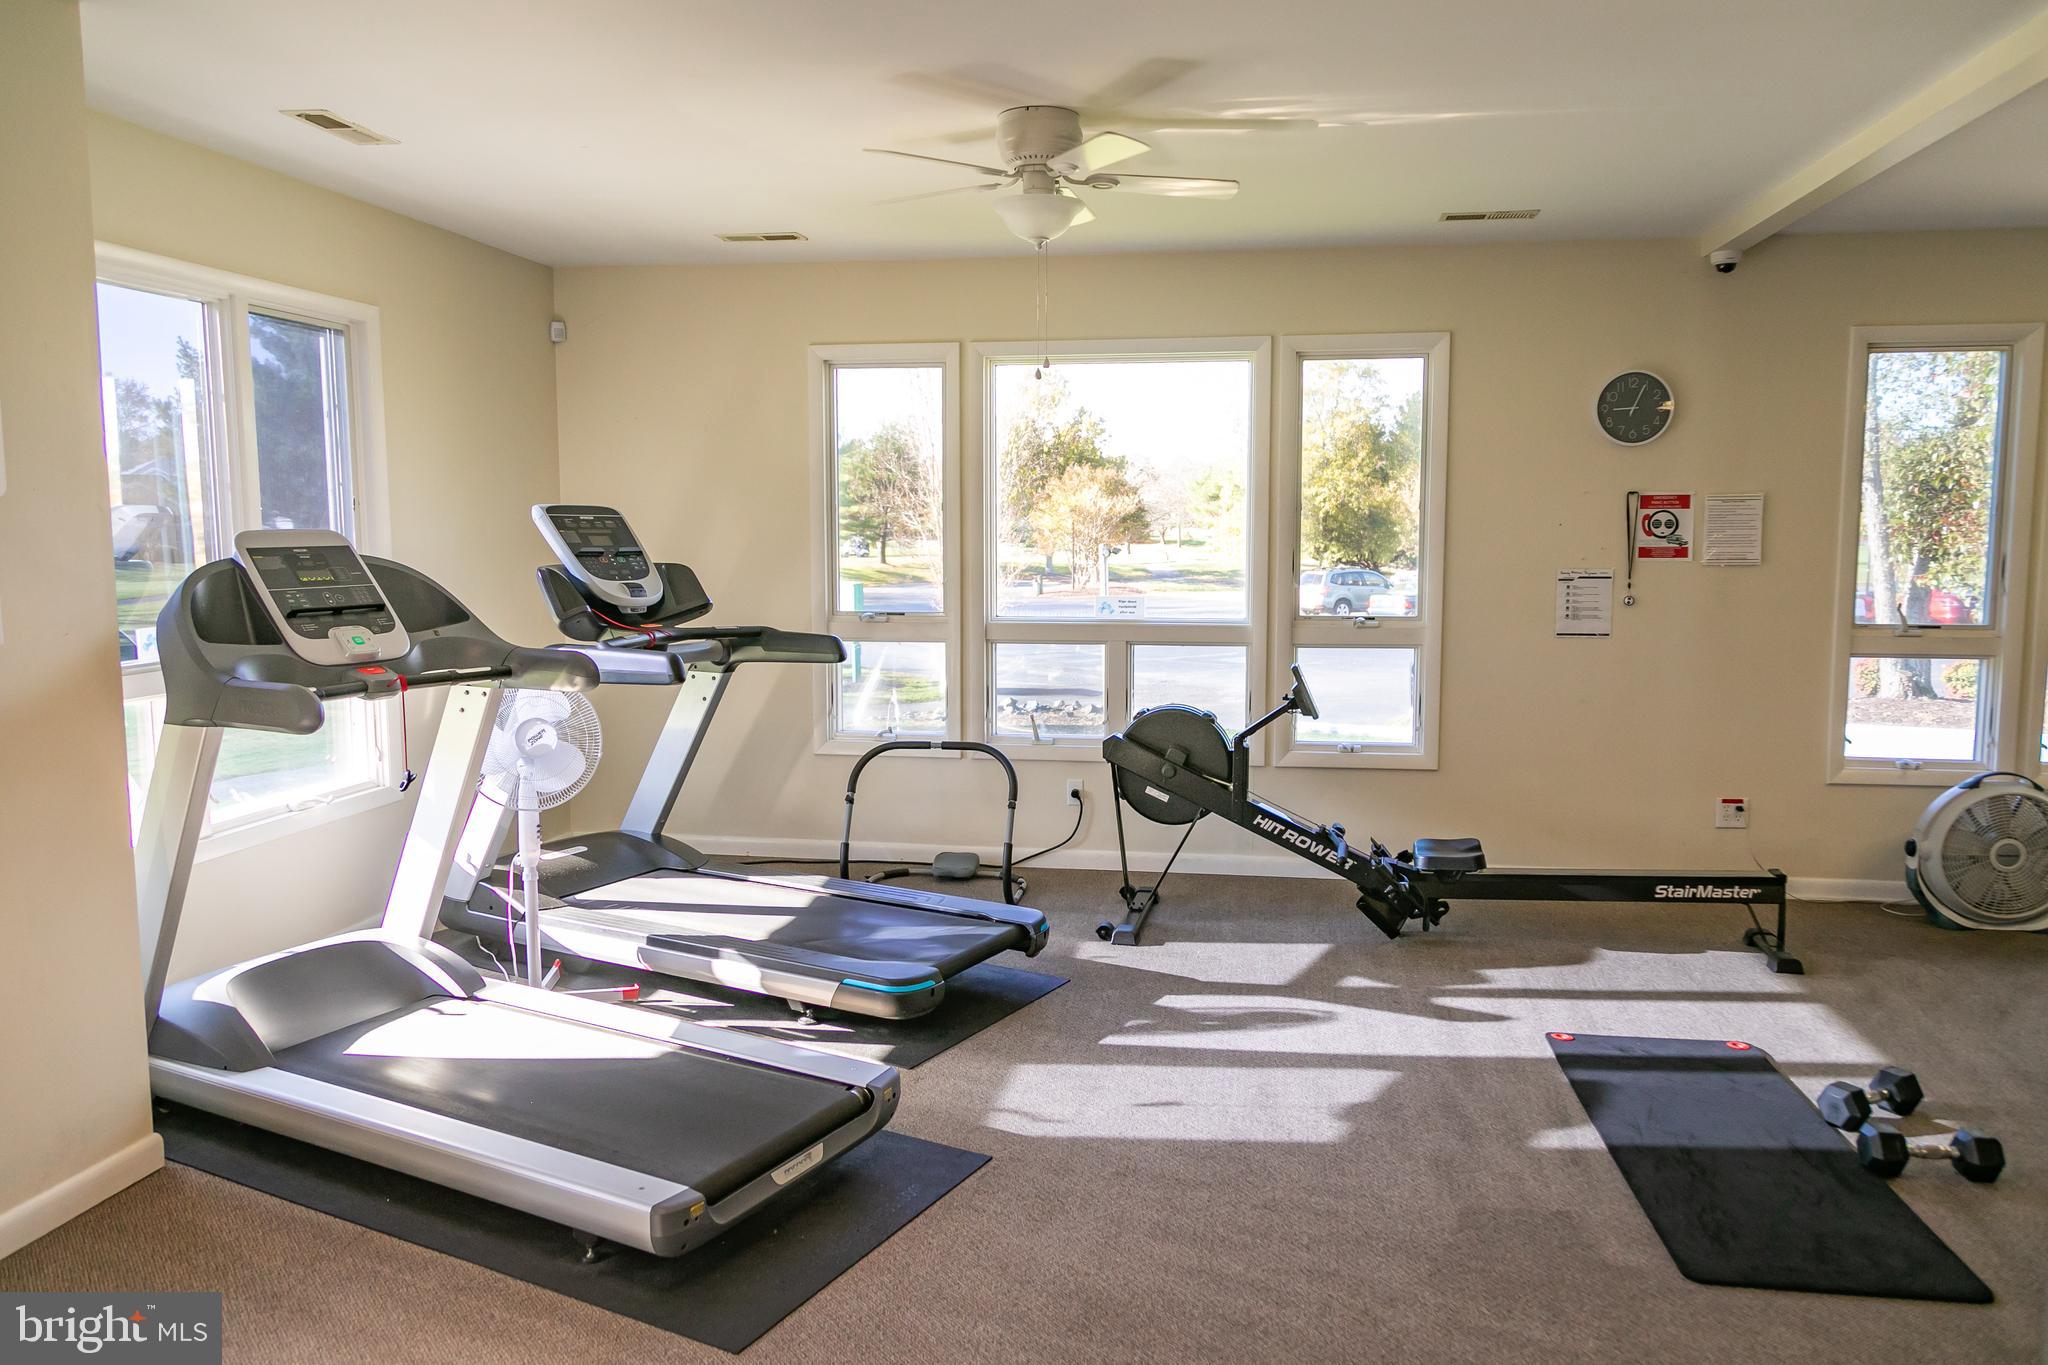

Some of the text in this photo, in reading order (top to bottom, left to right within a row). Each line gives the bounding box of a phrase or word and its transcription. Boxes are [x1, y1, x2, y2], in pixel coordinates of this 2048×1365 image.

[1616, 382, 1625, 392] 11
[1628, 377, 1640, 388] 12
[1606, 391, 1619, 402] 10
[1653, 389, 1664, 400] 2
[1601, 404, 1610, 414] 9
[1605, 417, 1613, 428] 8
[1652, 416, 1660, 425] 4
[1616, 426, 1625, 436] 7
[1628, 430, 1638, 440] 6
[1642, 425, 1650, 435] 5
[1253, 815, 1285, 835] HIIT
[1654, 885, 1758, 899] StairMaster
